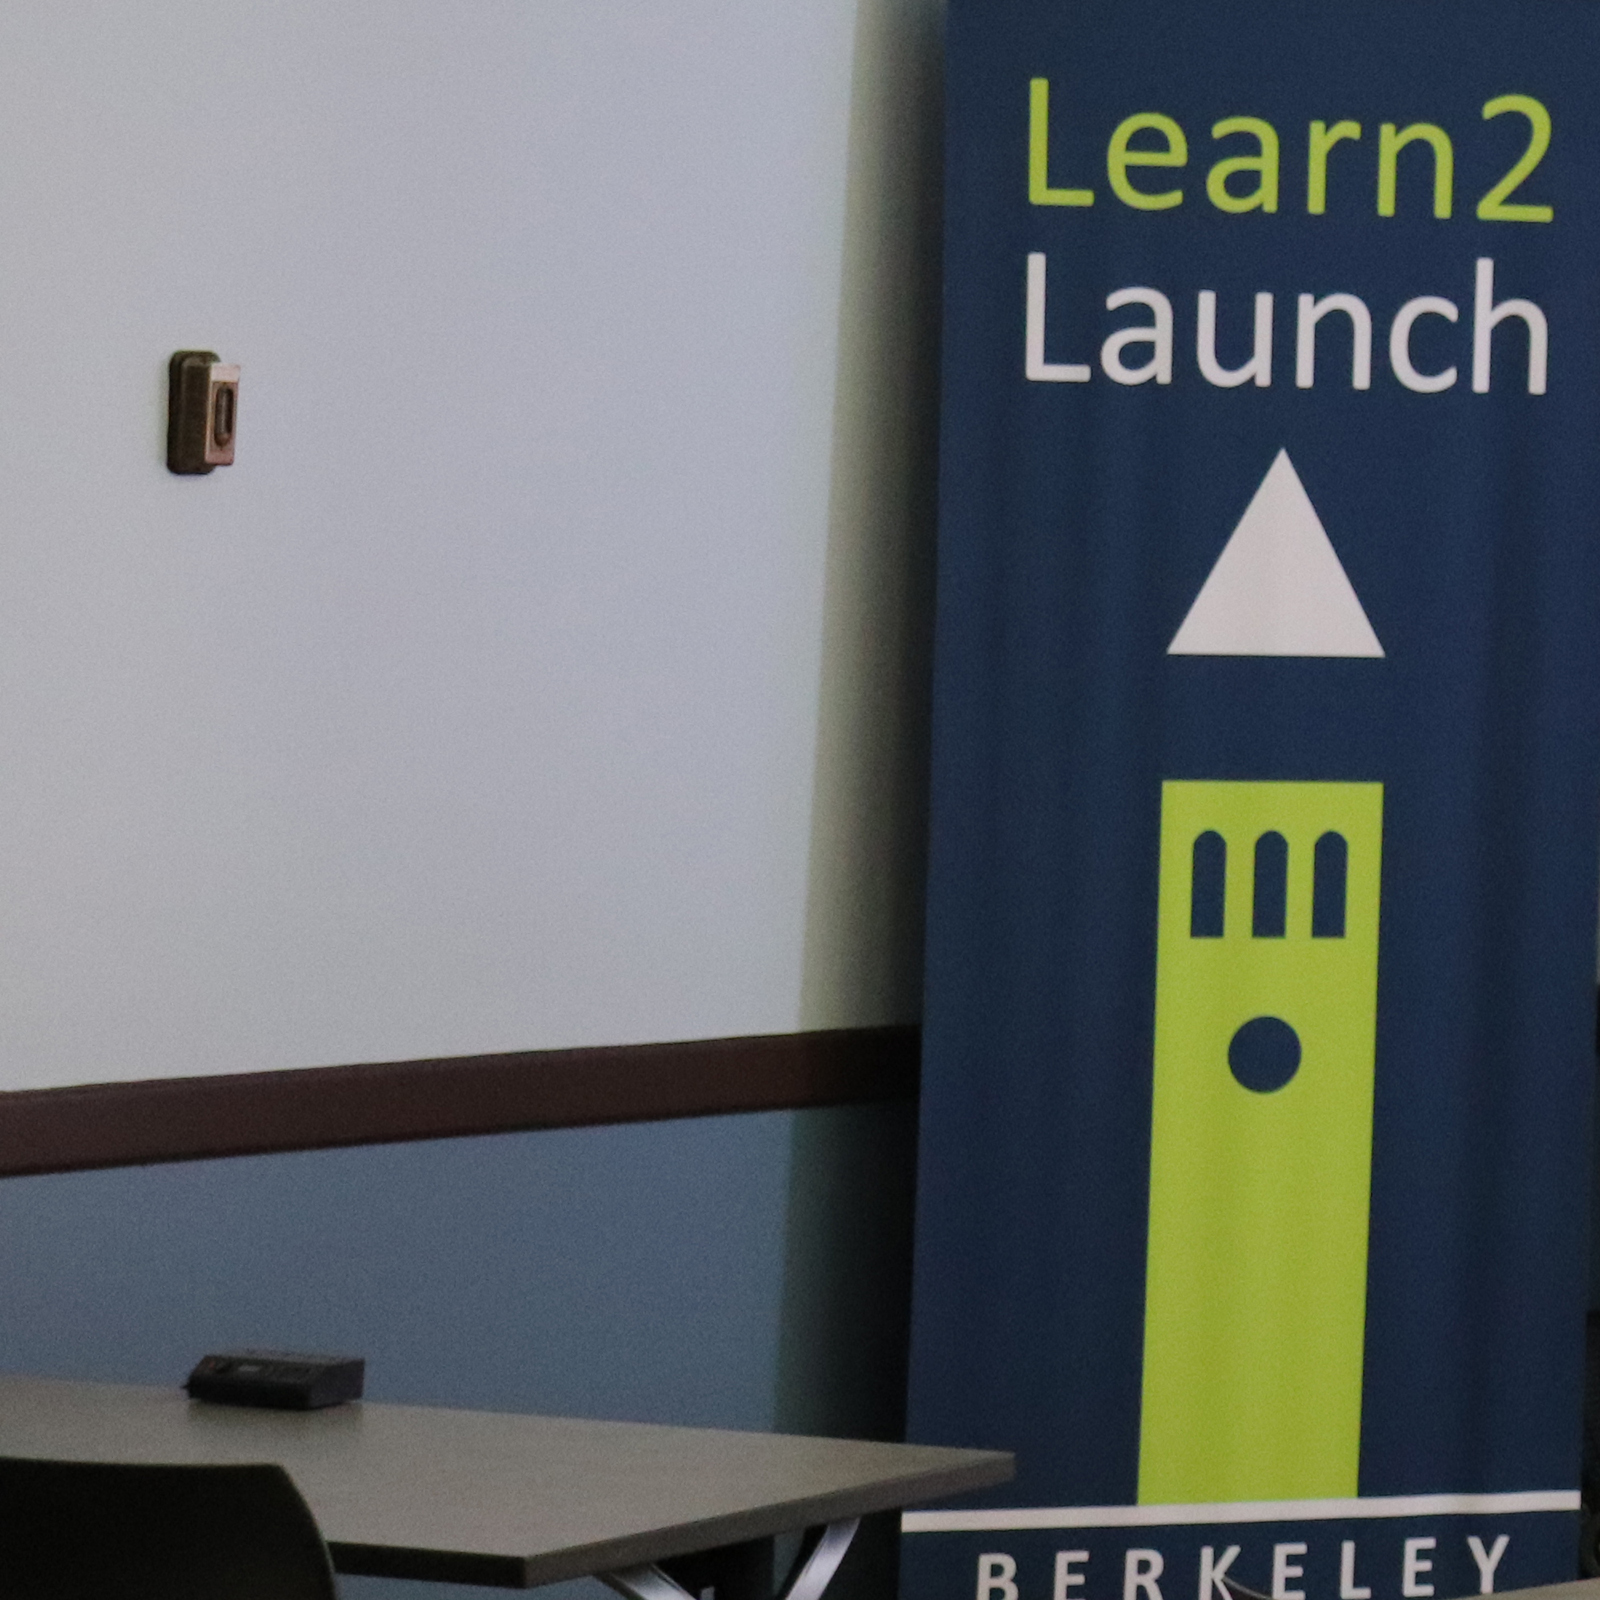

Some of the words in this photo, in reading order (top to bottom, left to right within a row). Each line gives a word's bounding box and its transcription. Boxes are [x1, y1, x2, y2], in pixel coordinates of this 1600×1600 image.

[1028, 77, 1554, 223] Learn2
[1025, 252, 1548, 395] Launch
[976, 1535, 1511, 1600] BERKELEY
